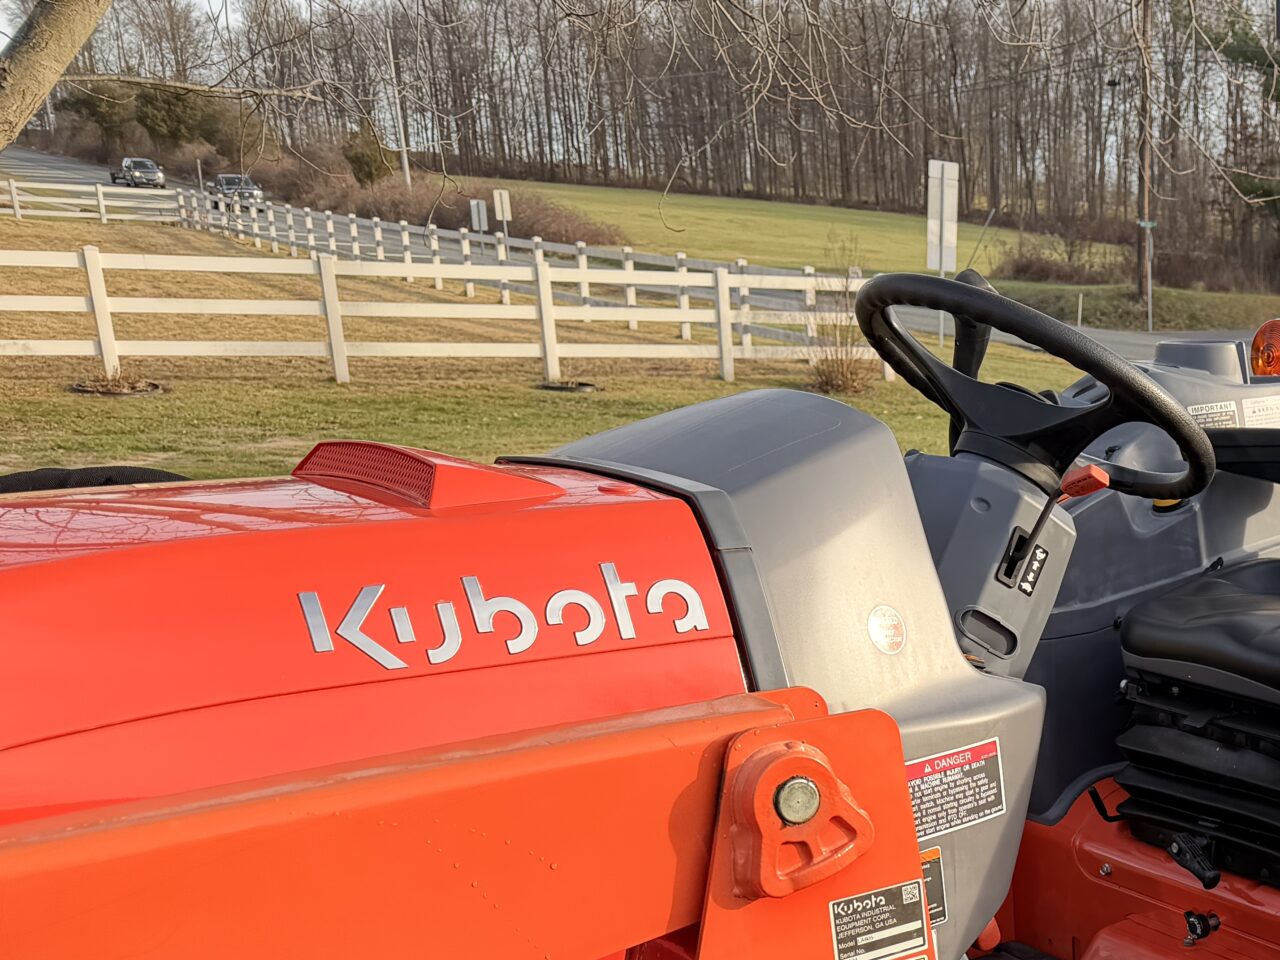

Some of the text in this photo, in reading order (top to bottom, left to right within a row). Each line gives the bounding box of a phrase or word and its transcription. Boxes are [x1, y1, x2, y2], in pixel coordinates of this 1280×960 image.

[1191, 403, 1232, 414] IMPORTANT
[298, 562, 709, 670] Kubota
[934, 751, 972, 770] DANGER
[834, 895, 885, 915] Kubota
[836, 904, 896, 925] KUBOTA INDUSTRIAL
[837, 912, 891, 932] EQUIPMENT CORP.
[839, 940, 855, 950] Model
[840, 951, 855, 960] Serial
